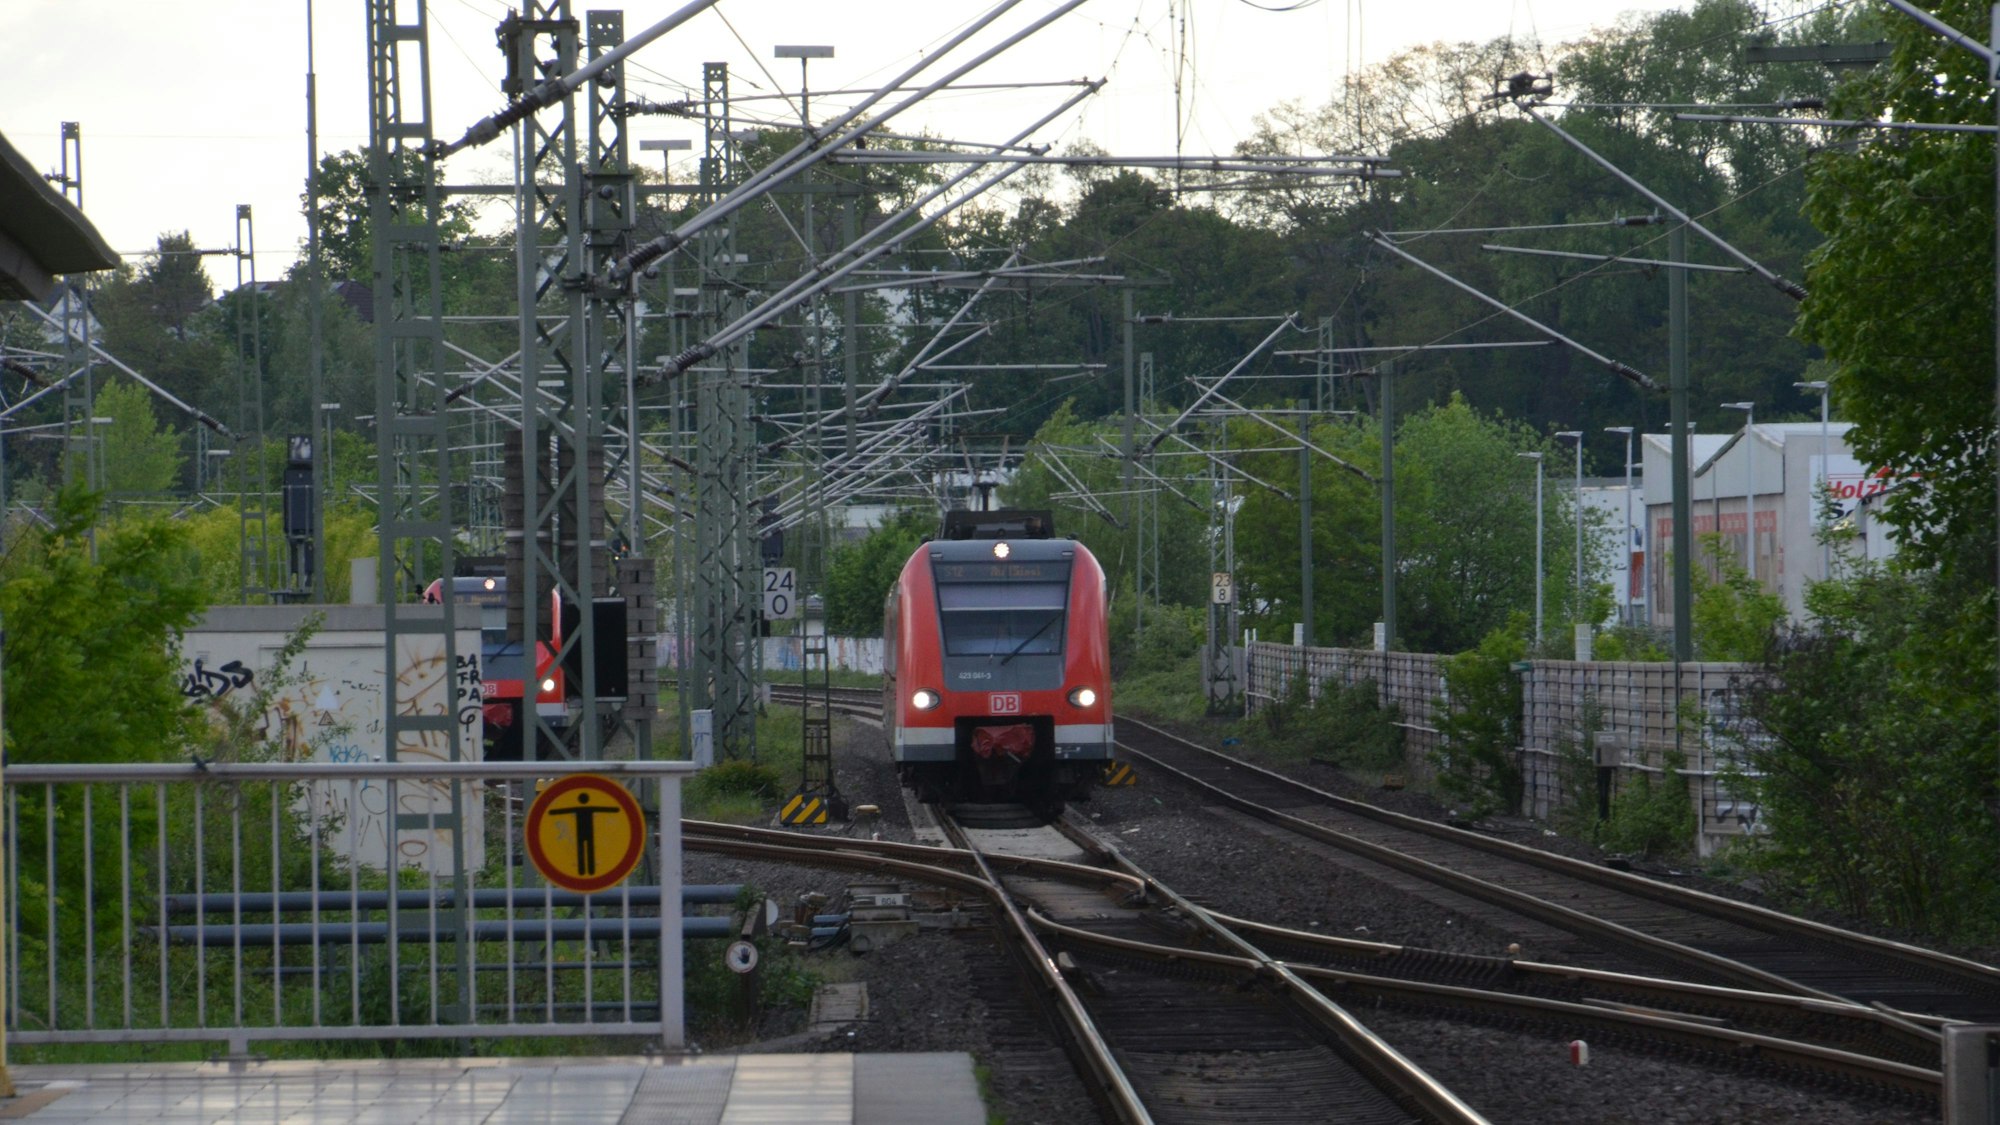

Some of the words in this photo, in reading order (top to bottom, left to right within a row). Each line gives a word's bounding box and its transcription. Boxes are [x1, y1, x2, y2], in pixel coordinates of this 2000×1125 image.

[765, 571, 794, 592] 24
[1215, 574, 1231, 587] 23
[1218, 588, 1226, 601] 8
[772, 594, 789, 616] 0
[991, 695, 1019, 713] DB
